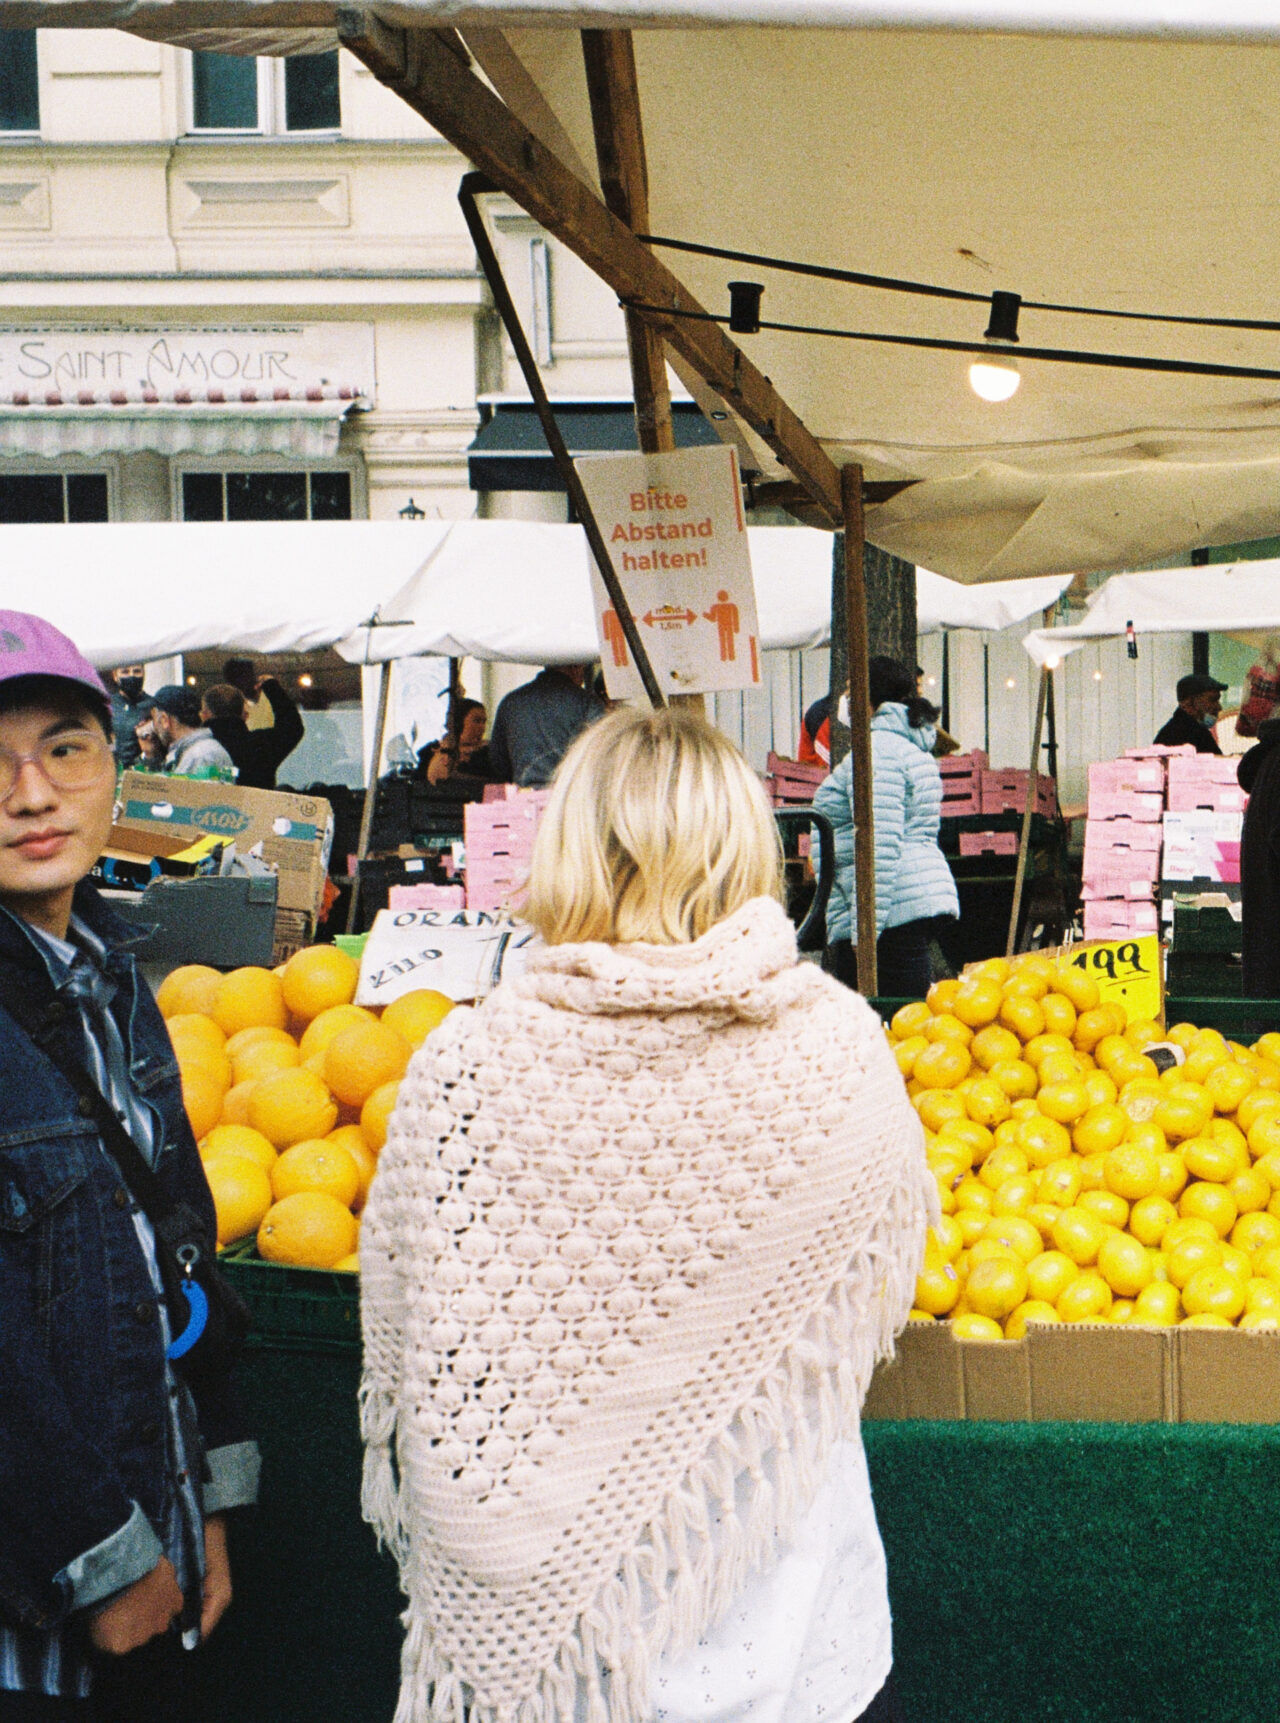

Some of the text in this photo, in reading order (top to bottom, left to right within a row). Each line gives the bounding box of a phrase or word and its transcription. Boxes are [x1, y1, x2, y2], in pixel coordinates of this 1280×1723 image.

[629, 491, 688, 512] Bitte
[610, 518, 713, 543] Abstand
[621, 547, 707, 571] halten!
[393, 911, 518, 928] ORAN
